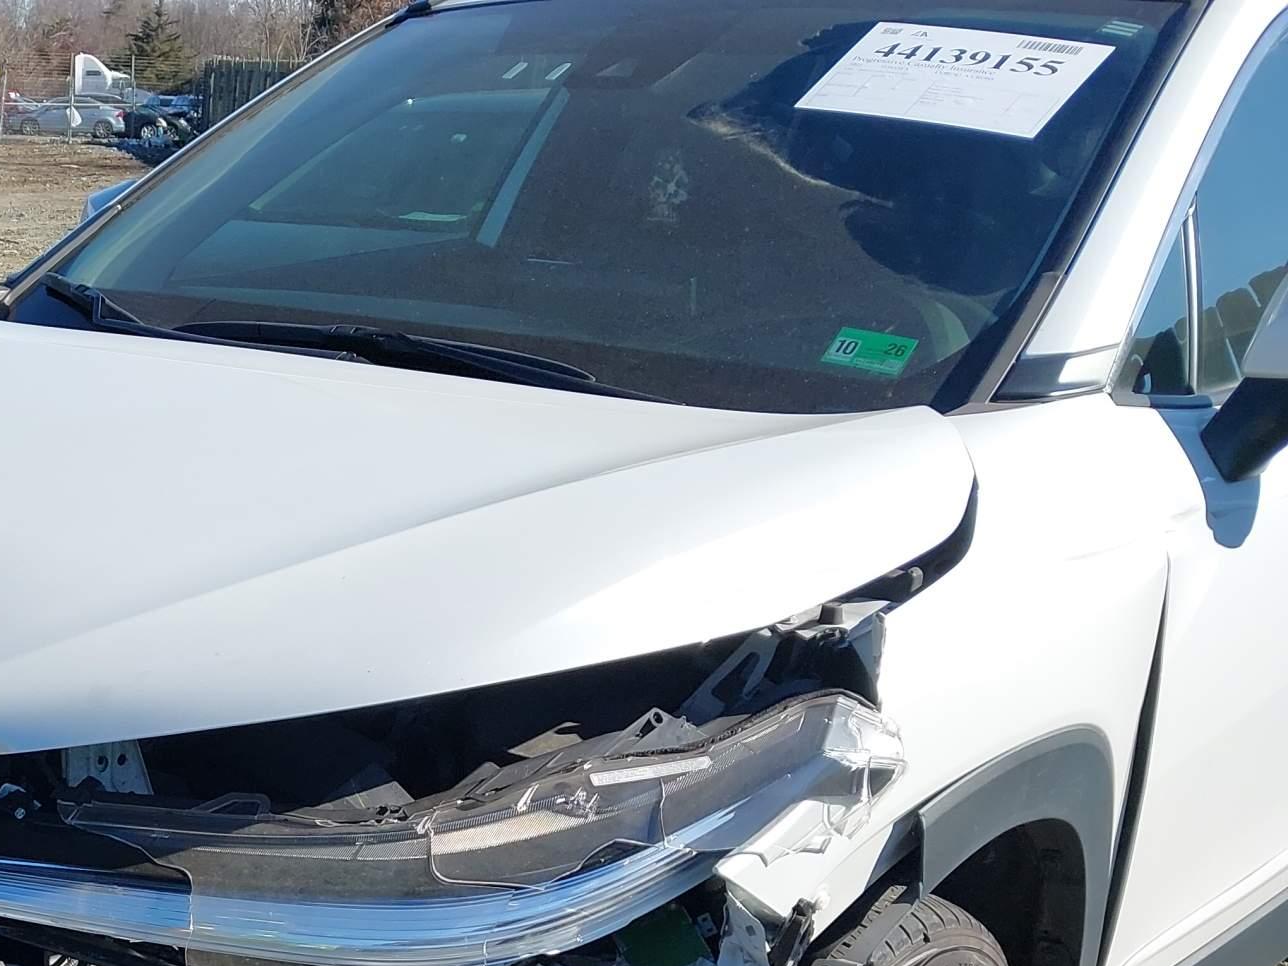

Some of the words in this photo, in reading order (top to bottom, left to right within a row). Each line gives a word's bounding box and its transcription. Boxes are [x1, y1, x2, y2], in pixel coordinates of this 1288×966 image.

[874, 42, 1067, 76] 44139155
[835, 339, 859, 355] 10
[884, 343, 908, 357] 26
